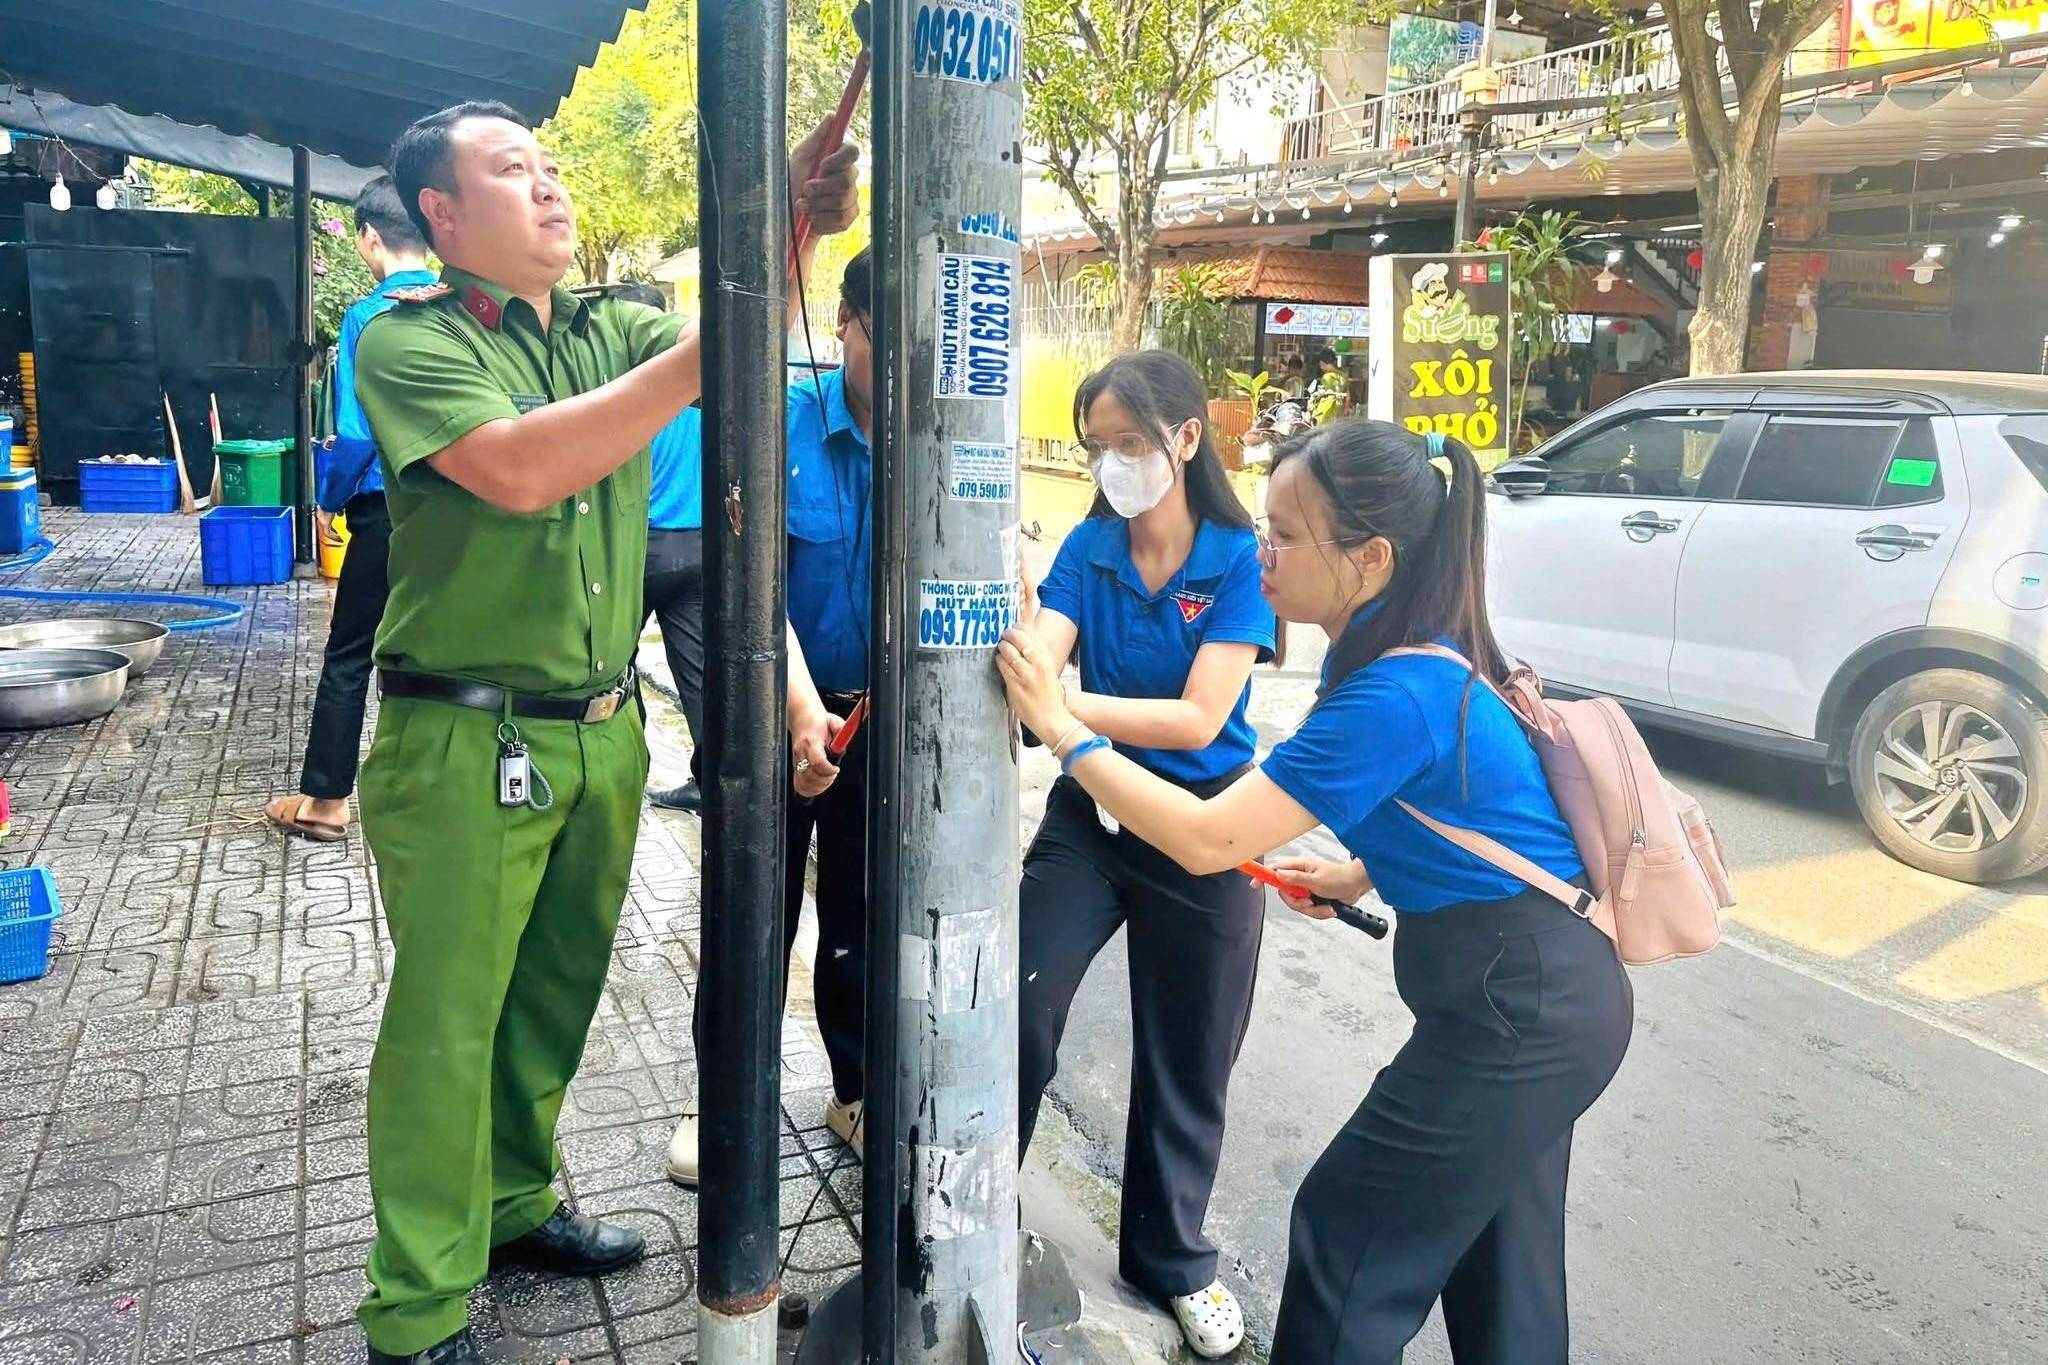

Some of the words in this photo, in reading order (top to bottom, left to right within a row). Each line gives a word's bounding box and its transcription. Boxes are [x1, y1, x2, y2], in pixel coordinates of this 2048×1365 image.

[940, 257, 960, 291] CẦU
[940, 292, 959, 330] HẦM
[967, 260, 1011, 397] 0907.626.814
[940, 332, 958, 365] HÚT
[1409, 349, 1493, 398] XÔI
[921, 581, 955, 596] THÔNG
[957, 581, 976, 596] CẦU
[936, 594, 965, 609] HÚT
[969, 594, 998, 609] HẦM
